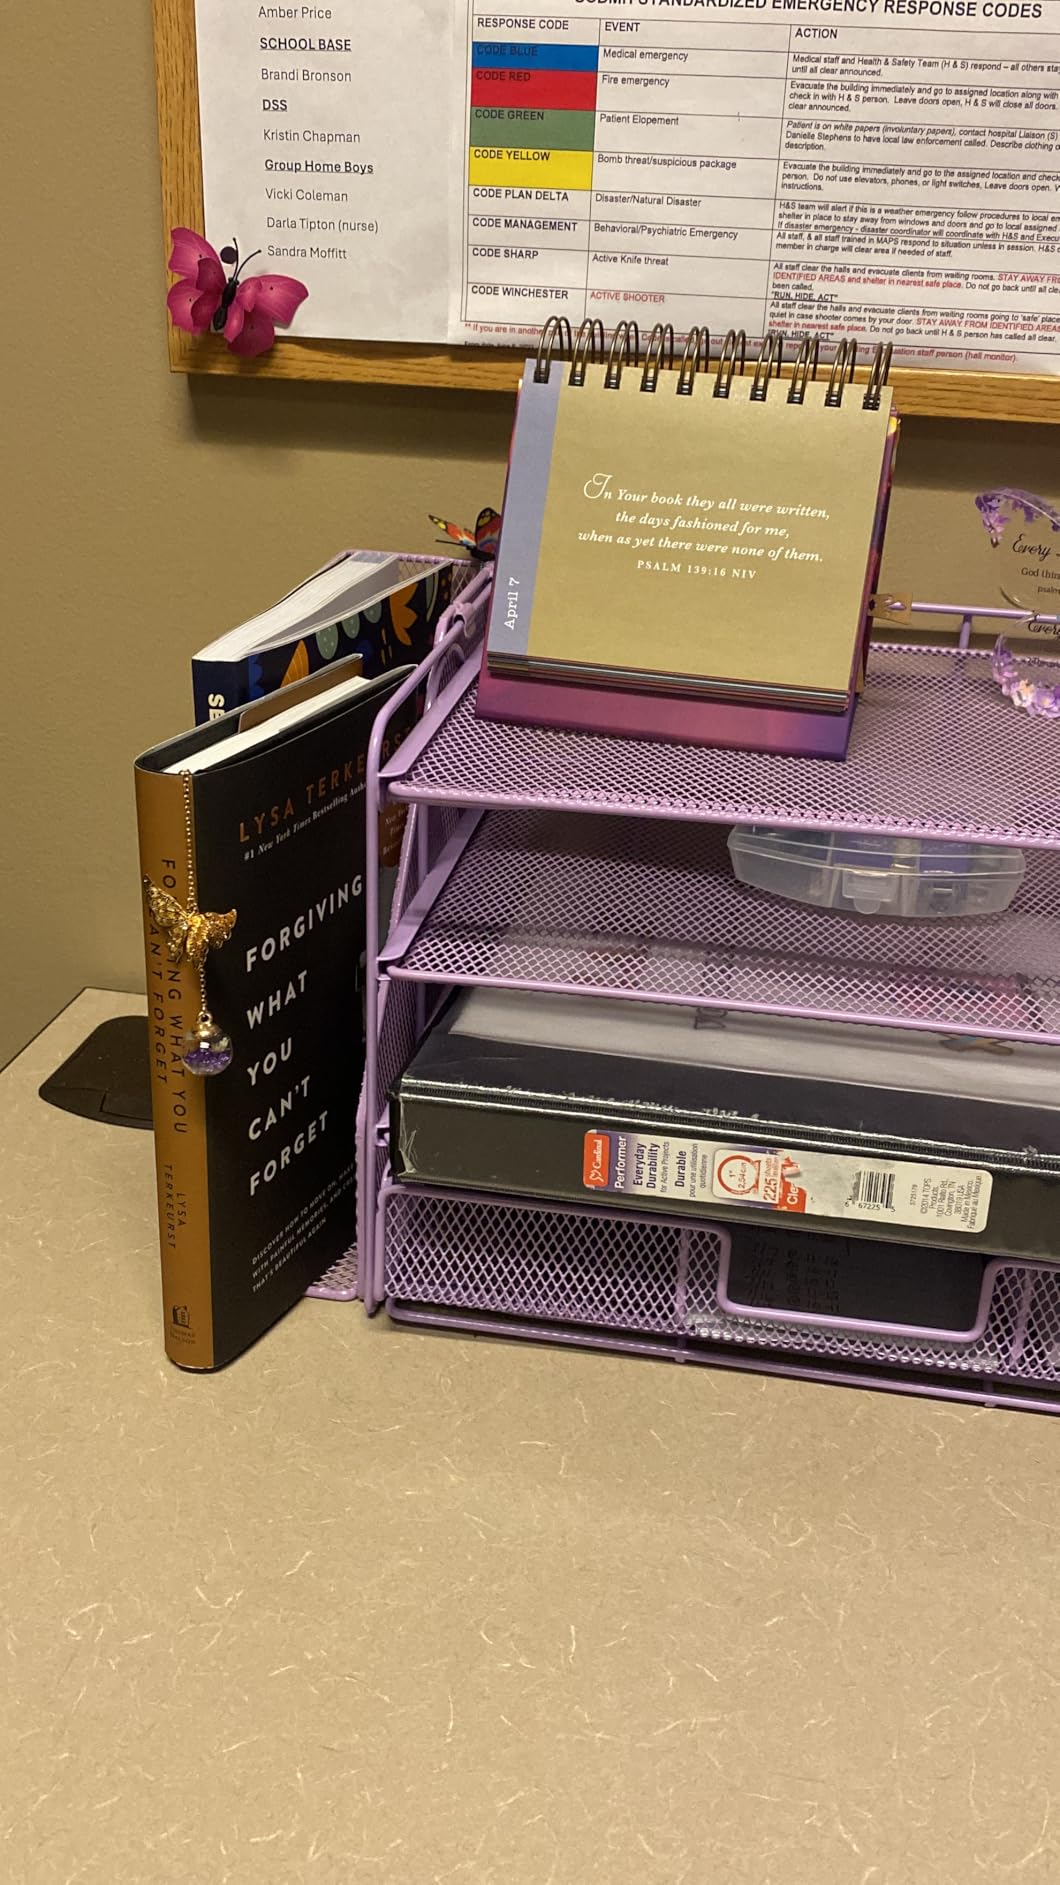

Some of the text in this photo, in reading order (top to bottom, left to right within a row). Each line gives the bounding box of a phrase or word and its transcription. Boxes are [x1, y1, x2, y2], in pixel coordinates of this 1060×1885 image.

[258, 6, 332, 19] Amber Price
[772, 0, 877, 13] EMERGENCY
[884, 0, 977, 17] RESPONSE
[982, 4, 1042, 18] CODES
[477, 18, 569, 30] RESPONSE CODE
[605, 22, 640, 32] EVENT
[795, 28, 838, 40] ACTION
[260, 37, 352, 52] SCHOOL BASE
[476, 44, 538, 56] CODE BLUE
[603, 48, 688, 62] Medical emergency
[792, 54, 821, 62] Medical
[824, 55, 840, 63] staff
[841, 56, 855, 64] and
[858, 57, 882, 66] Health
[884, 58, 889, 66] &
[892, 58, 915, 68] Safety
[918, 59, 939, 68] Team
[970, 62, 1002, 71] respond
[1021, 64, 1044, 72] others
[261, 68, 352, 82] Brandi Bronson
[476, 70, 531, 81] CODE RED
[792, 65, 808, 73] until
[809, 66, 818, 74] all
[820, 67, 838, 75] clear
[602, 74, 670, 88] Fire emergency
[262, 98, 288, 112] DSS
[475, 109, 544, 120] CODE GREEN
[600, 114, 679, 128] Patient Elopement
[263, 129, 360, 144] Kristin Chapman
[474, 149, 550, 161] CODE YELLOW
[597, 154, 737, 171] Bomb threat/suspicious package
[264, 159, 374, 175] Group Home Boys
[265, 188, 348, 202] Vicki Coleman
[473, 188, 569, 201] CODE PLAN DELTA
[595, 193, 702, 207] Disaster/Natural Disaster
[267, 217, 378, 234] Darla Tipton (nurse)
[472, 218, 578, 231] CODE MANAGEMENT
[594, 223, 738, 240] Behavioral/Psychiatric Emergency
[267, 246, 347, 260] Sandra Moffitt
[472, 248, 539, 259] CODE SHARP
[592, 254, 669, 266] Active Knife threat
[471, 285, 569, 300] CODE WINCHESTER
[590, 291, 665, 303] ACTIVE SHOOTER
[584, 473, 830, 520] In Your book they all were written,
[616, 511, 790, 539] the days fashioned for me,
[578, 530, 823, 562] when as yet there were none of them.
[637, 560, 756, 579] PSALM 139:16 NIV
[1021, 567, 1039, 577] God
[504, 577, 520, 630] April 7
[240, 798, 294, 842] LYSA
[244, 849, 254, 860] #1
[258, 841, 274, 855] New
[276, 828, 290, 844] York
[293, 817, 311, 833] Times
[312, 793, 348, 820] Bestselling
[246, 874, 363, 973] FORGIVING
[246, 970, 308, 1030] WHAT
[153, 992, 168, 1083] FORGET
[169, 1015, 185, 1077] WHAT
[247, 1037, 292, 1087] YOU
[172, 1090, 188, 1133] YOU
[248, 1075, 310, 1140] CAN'T
[250, 1110, 328, 1197] FORGET
[662, 1141, 670, 1165] Projects
[691, 1144, 699, 1172] utilisation
[614, 1136, 628, 1189] Performer
[633, 1143, 647, 1186] Everyday
[646, 1142, 660, 1189] Durability
[675, 1150, 687, 1187] Durable
[700, 1154, 708, 1188] quotidienne
[763, 1178, 778, 1201] 225
[164, 1164, 176, 1249] TERKEURST
[176, 1191, 187, 1227] LYSA
[252, 1230, 284, 1265] DISCOVER
[285, 1215, 299, 1232] HOW
[300, 1206, 309, 1217] TO
[310, 1189, 326, 1208] MOVE
[275, 1237, 306, 1271] BEAUTIFUL
[308, 1218, 326, 1238] AGAIN
[252, 1259, 269, 1278] WITH
[270, 1233, 295, 1262] PAINFUL
